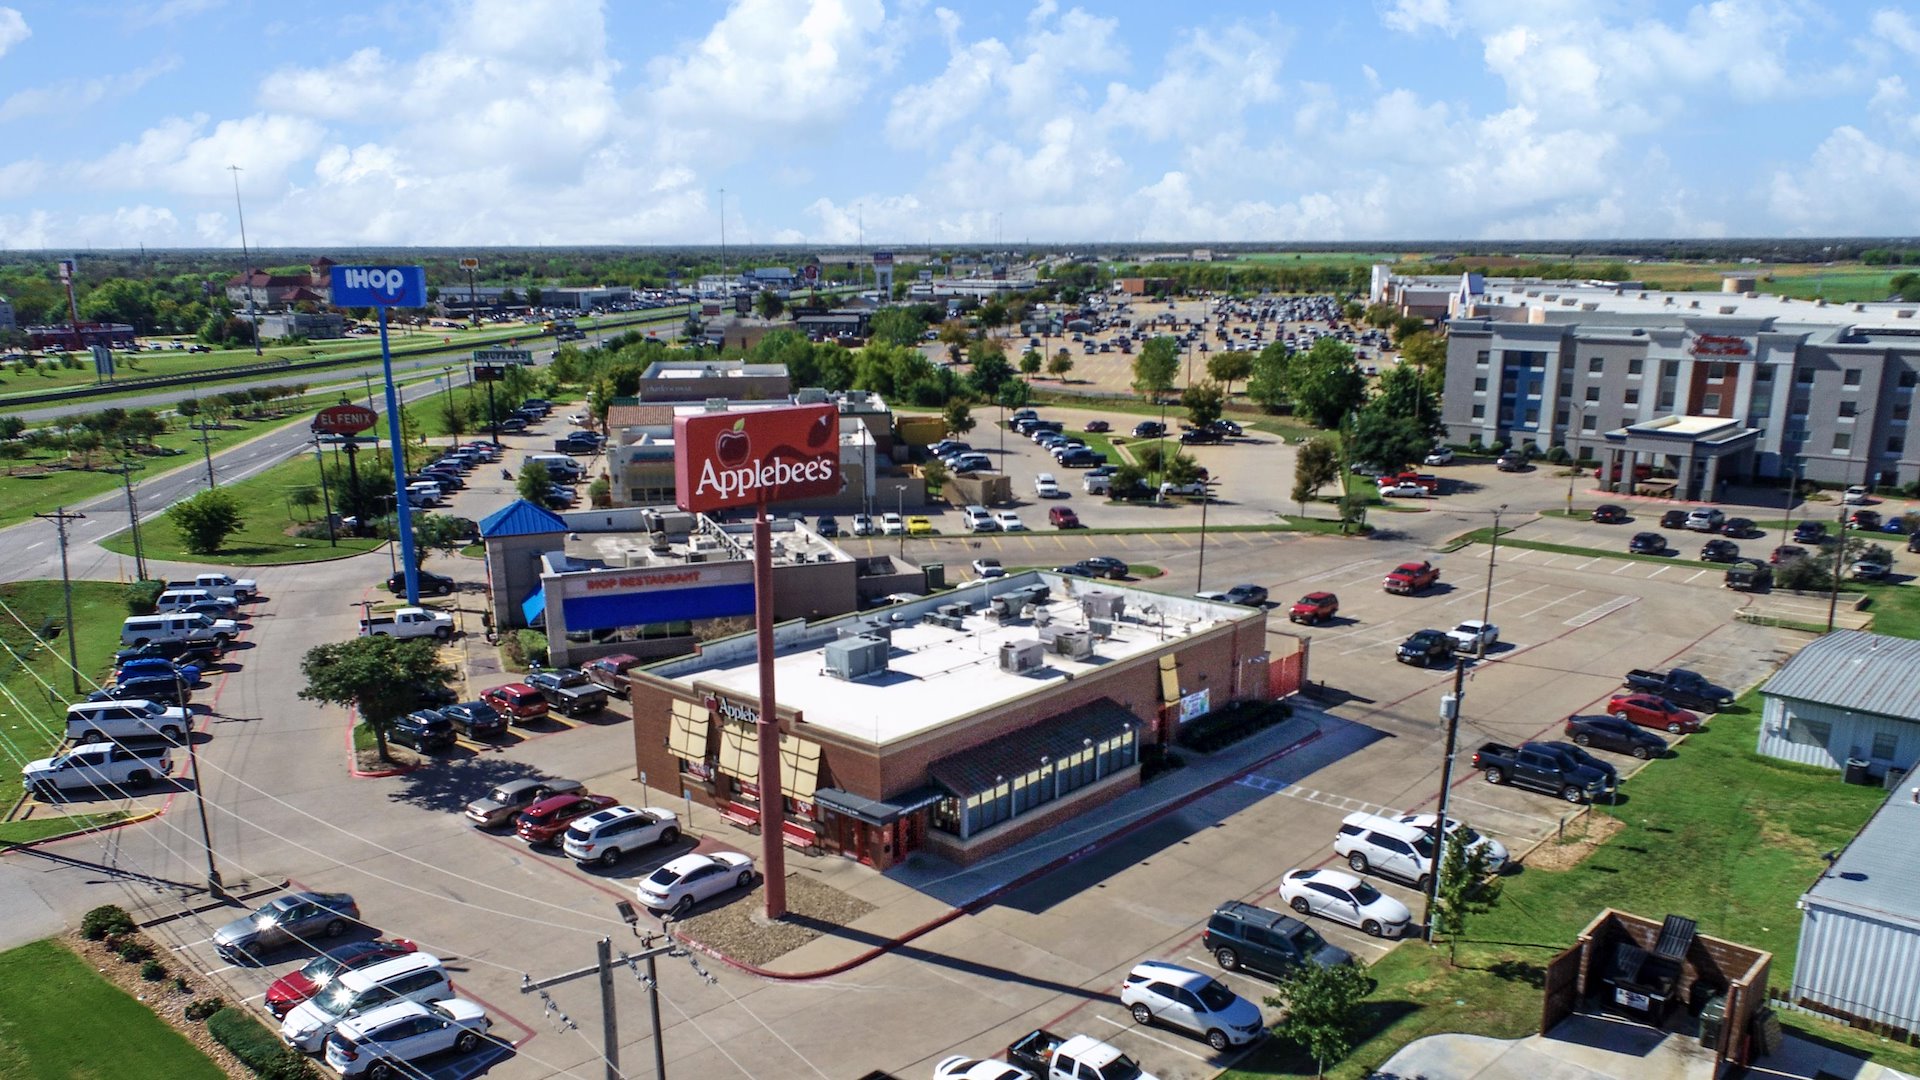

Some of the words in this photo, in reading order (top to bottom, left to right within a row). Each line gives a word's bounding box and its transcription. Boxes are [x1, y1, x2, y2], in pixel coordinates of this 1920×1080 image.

[344, 268, 404, 296] IHOP
[321, 413, 335, 425] EL
[337, 412, 371, 425] FENIX
[695, 455, 833, 499] Applebee's
[619, 570, 700, 588] RESTAURANT
